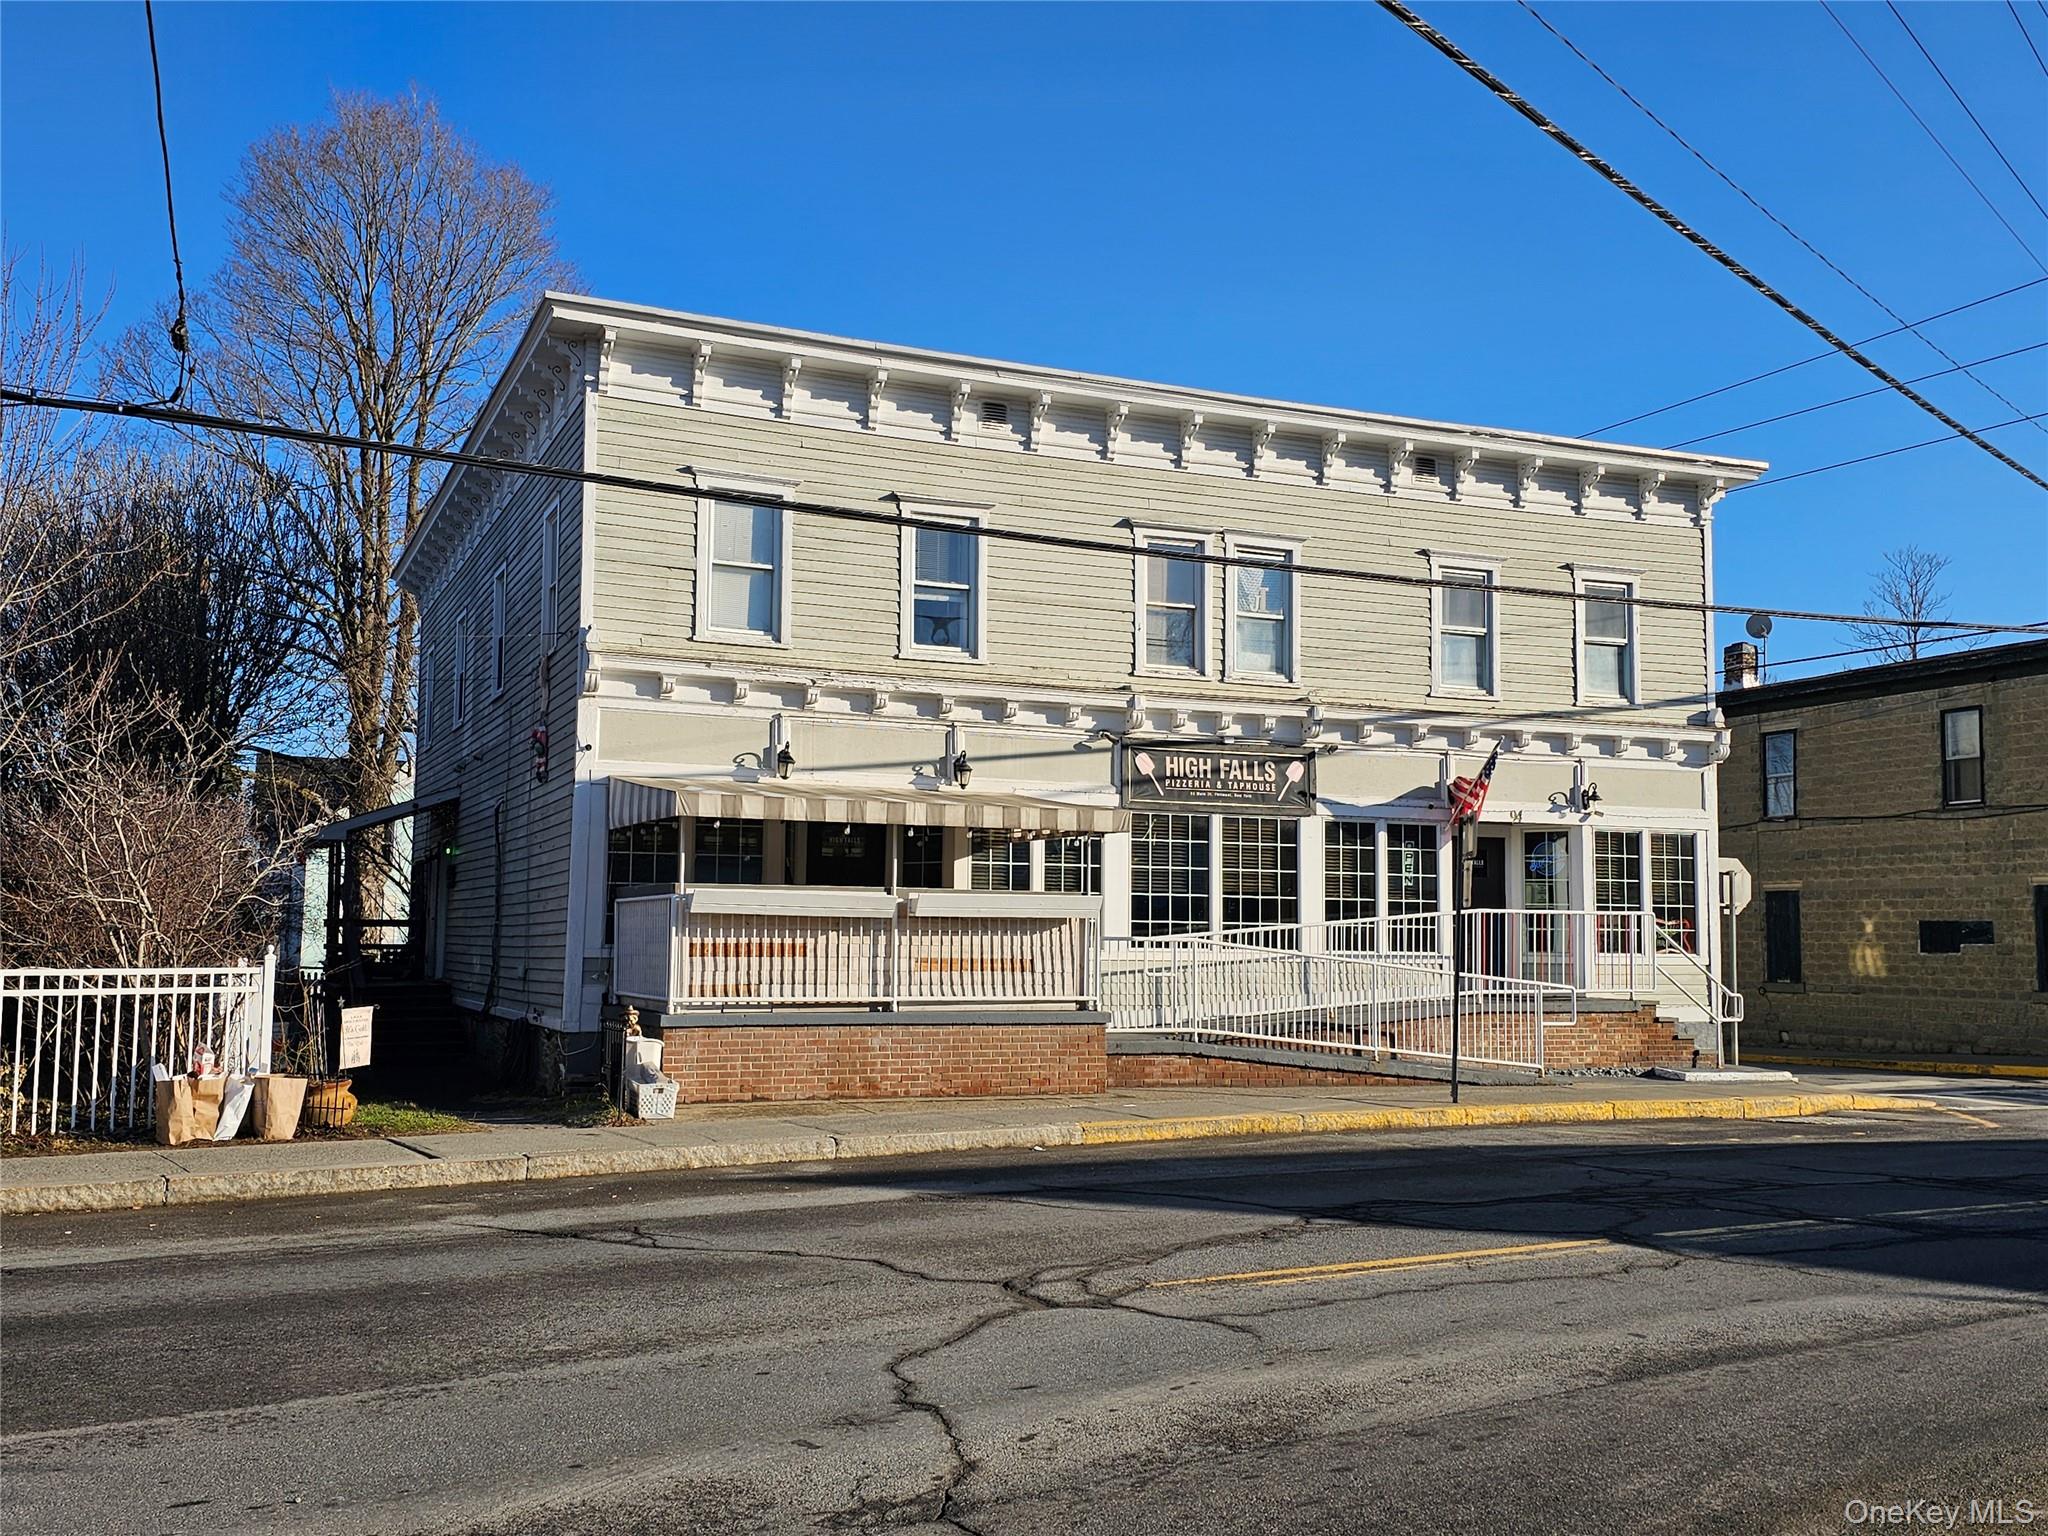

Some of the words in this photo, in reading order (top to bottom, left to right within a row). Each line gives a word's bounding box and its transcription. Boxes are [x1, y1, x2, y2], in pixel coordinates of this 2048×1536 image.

[1165, 756, 1212, 779] HIGH
[1219, 758, 1277, 782] FALLS
[1165, 779, 1211, 789] PIZZERIA
[1216, 781, 1222, 789] &
[1228, 782, 1276, 792] TAPHOUSE
[1510, 810, 1523, 823] 94
[1405, 842, 1414, 884] OPEN
